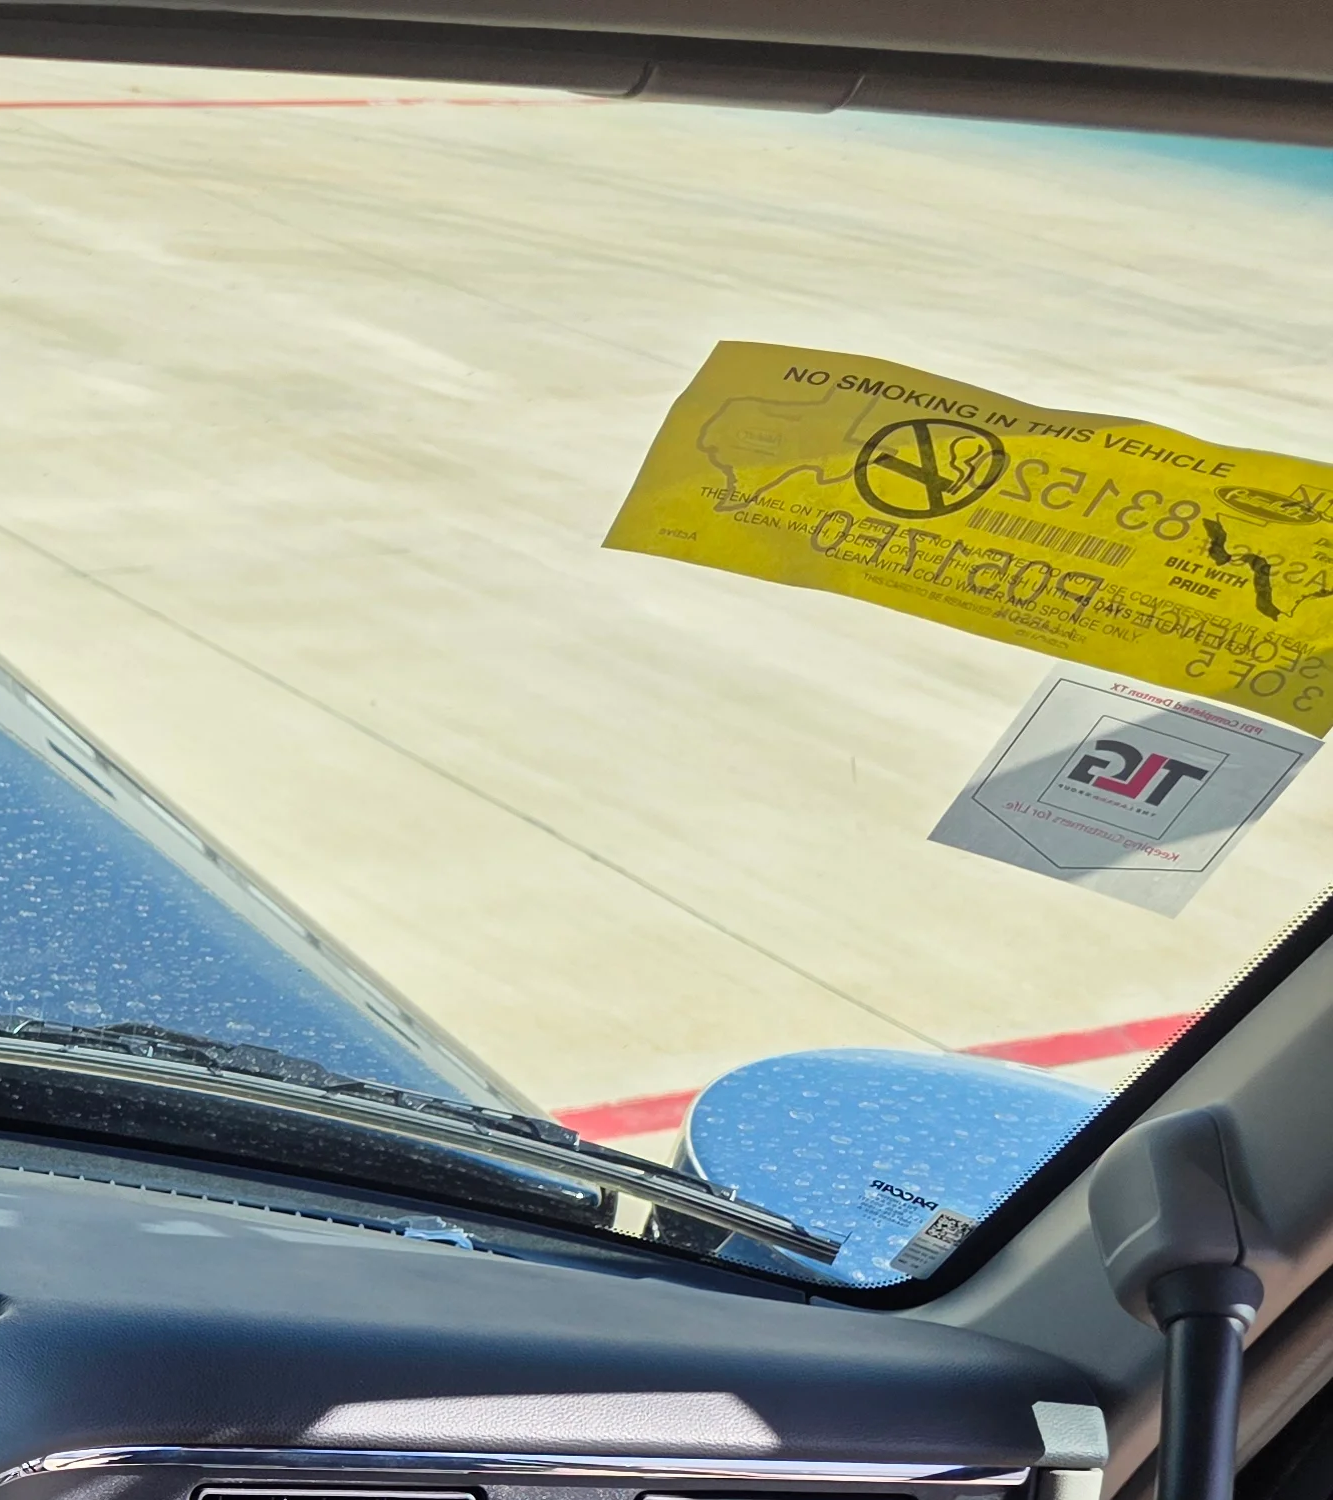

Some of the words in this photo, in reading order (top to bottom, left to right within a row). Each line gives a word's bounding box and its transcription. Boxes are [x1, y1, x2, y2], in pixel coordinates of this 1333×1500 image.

[782, 366, 830, 386] NO
[836, 374, 980, 419] SMOKING
[984, 411, 1019, 430] IN
[1027, 420, 1095, 443] THIS
[1102, 432, 1237, 478] VEHICLE
[733, 510, 783, 531] CLEAN,
[700, 486, 726, 501] THE
[729, 491, 786, 512] ENAMEL
[789, 503, 812, 517] ON
[815, 508, 847, 525] THIS
[965, 545, 1003, 563] HARD
[1038, 563, 1062, 578] DO
[1097, 579, 1129, 598] USE
[1129, 590, 1232, 628] COMPRESSED
[1264, 631, 1316, 657] STEAM
[824, 547, 871, 565] CLEAN
[874, 559, 911, 577] WITH
[912, 568, 954, 587] COLD
[954, 580, 1006, 603] WATER
[1039, 604, 1101, 632] SPONGE
[1164, 555, 1203, 576] BILT
[1205, 565, 1250, 589] WITH
[1167, 575, 1222, 601] PRIDE
